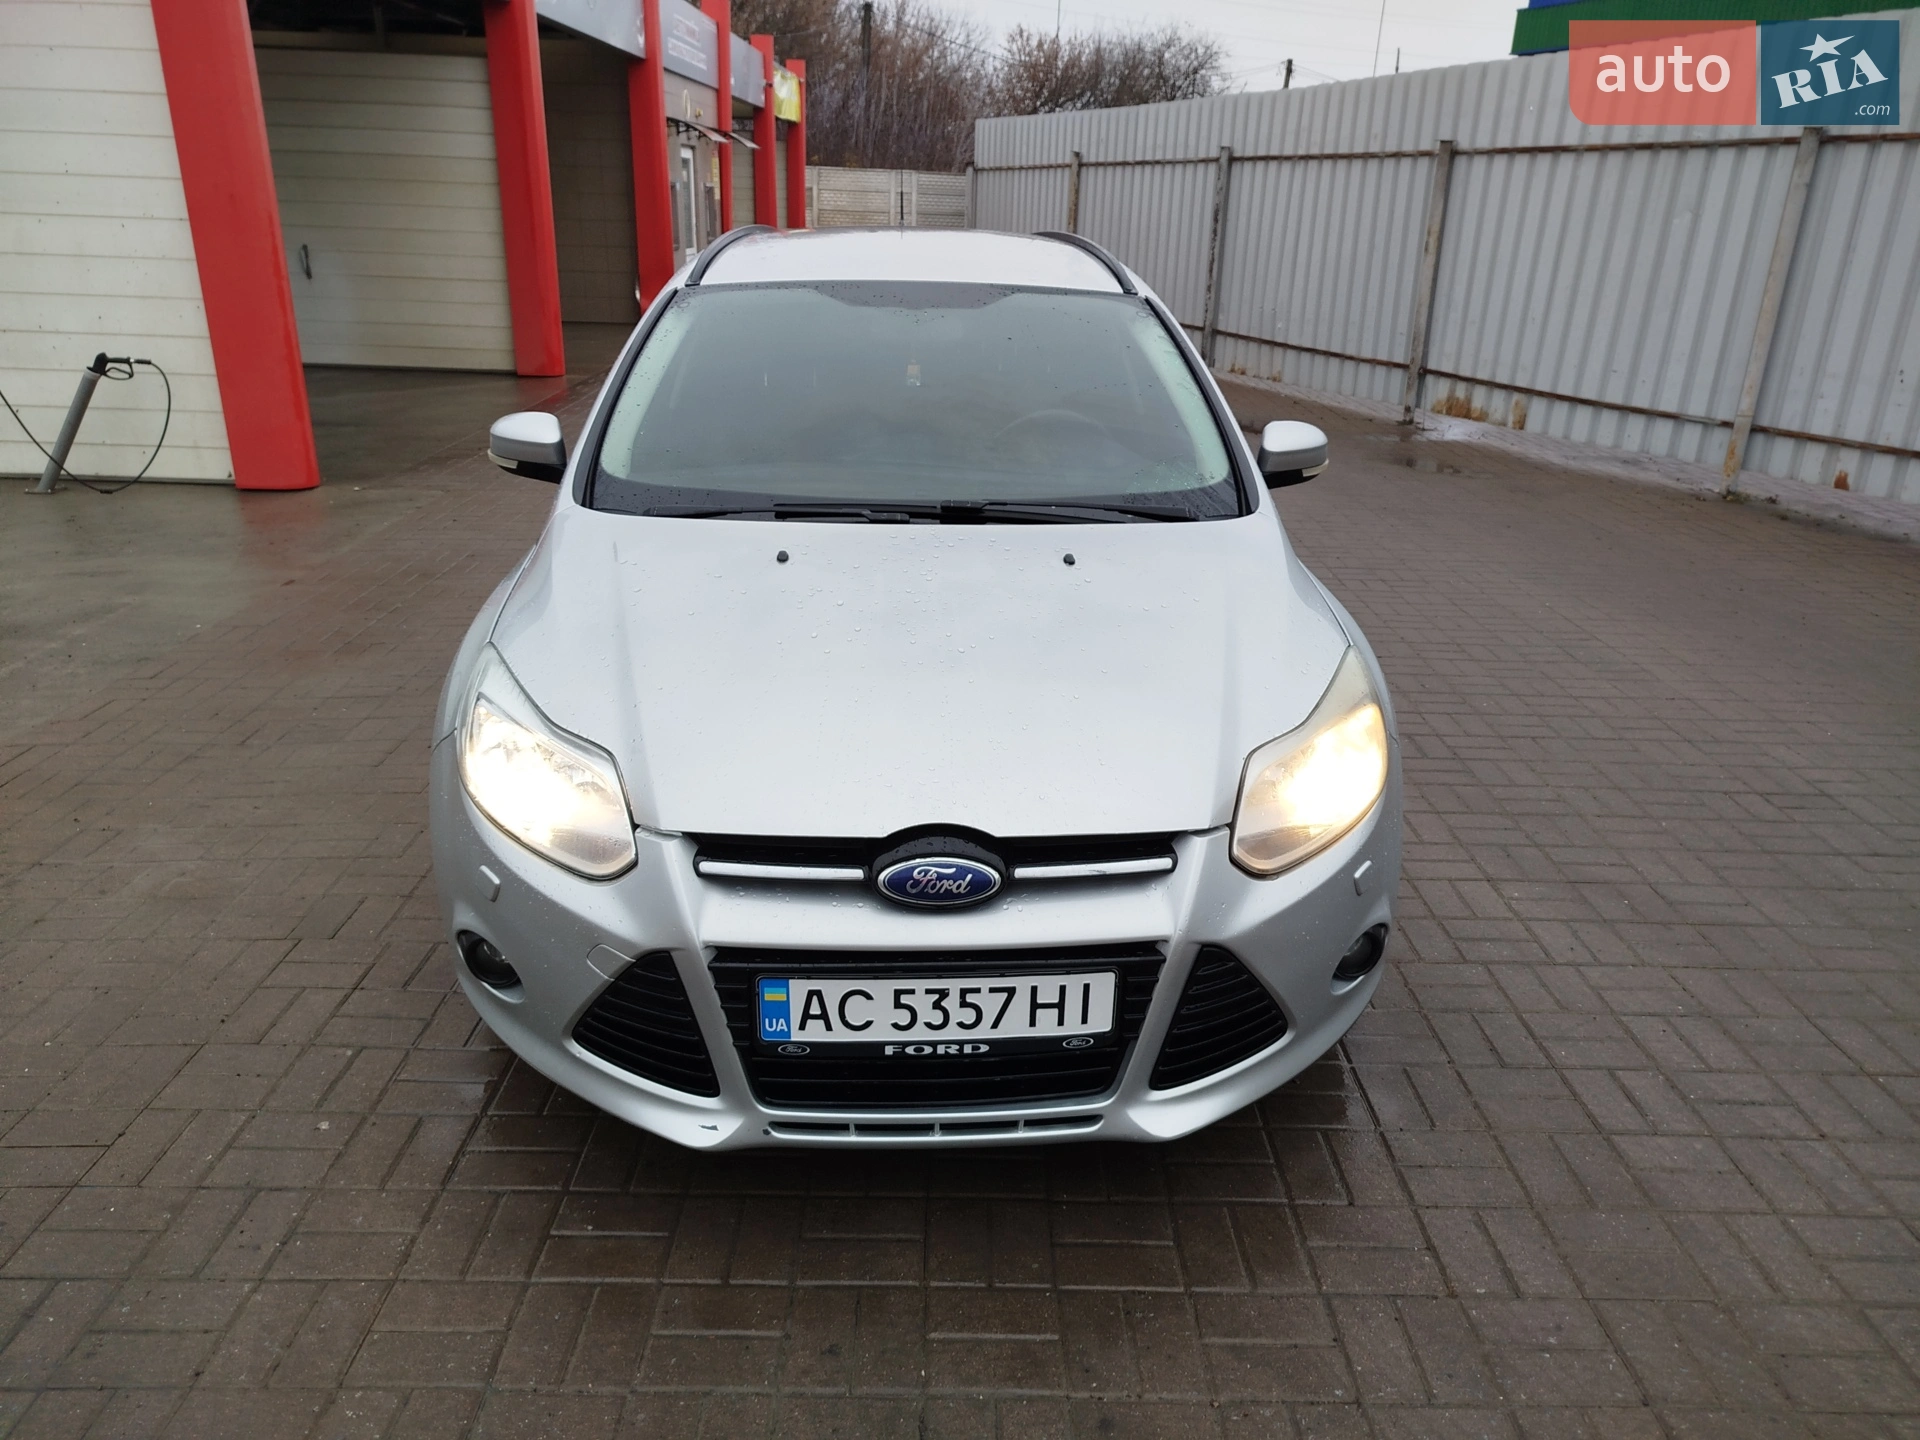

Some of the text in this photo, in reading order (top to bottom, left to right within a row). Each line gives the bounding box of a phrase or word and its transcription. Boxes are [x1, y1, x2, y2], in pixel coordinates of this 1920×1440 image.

[905, 866, 973, 894] Ford
[798, 982, 1091, 1032] AC 5357 HI
[764, 1018, 789, 1033] UA
[884, 1043, 990, 1056] FORD
